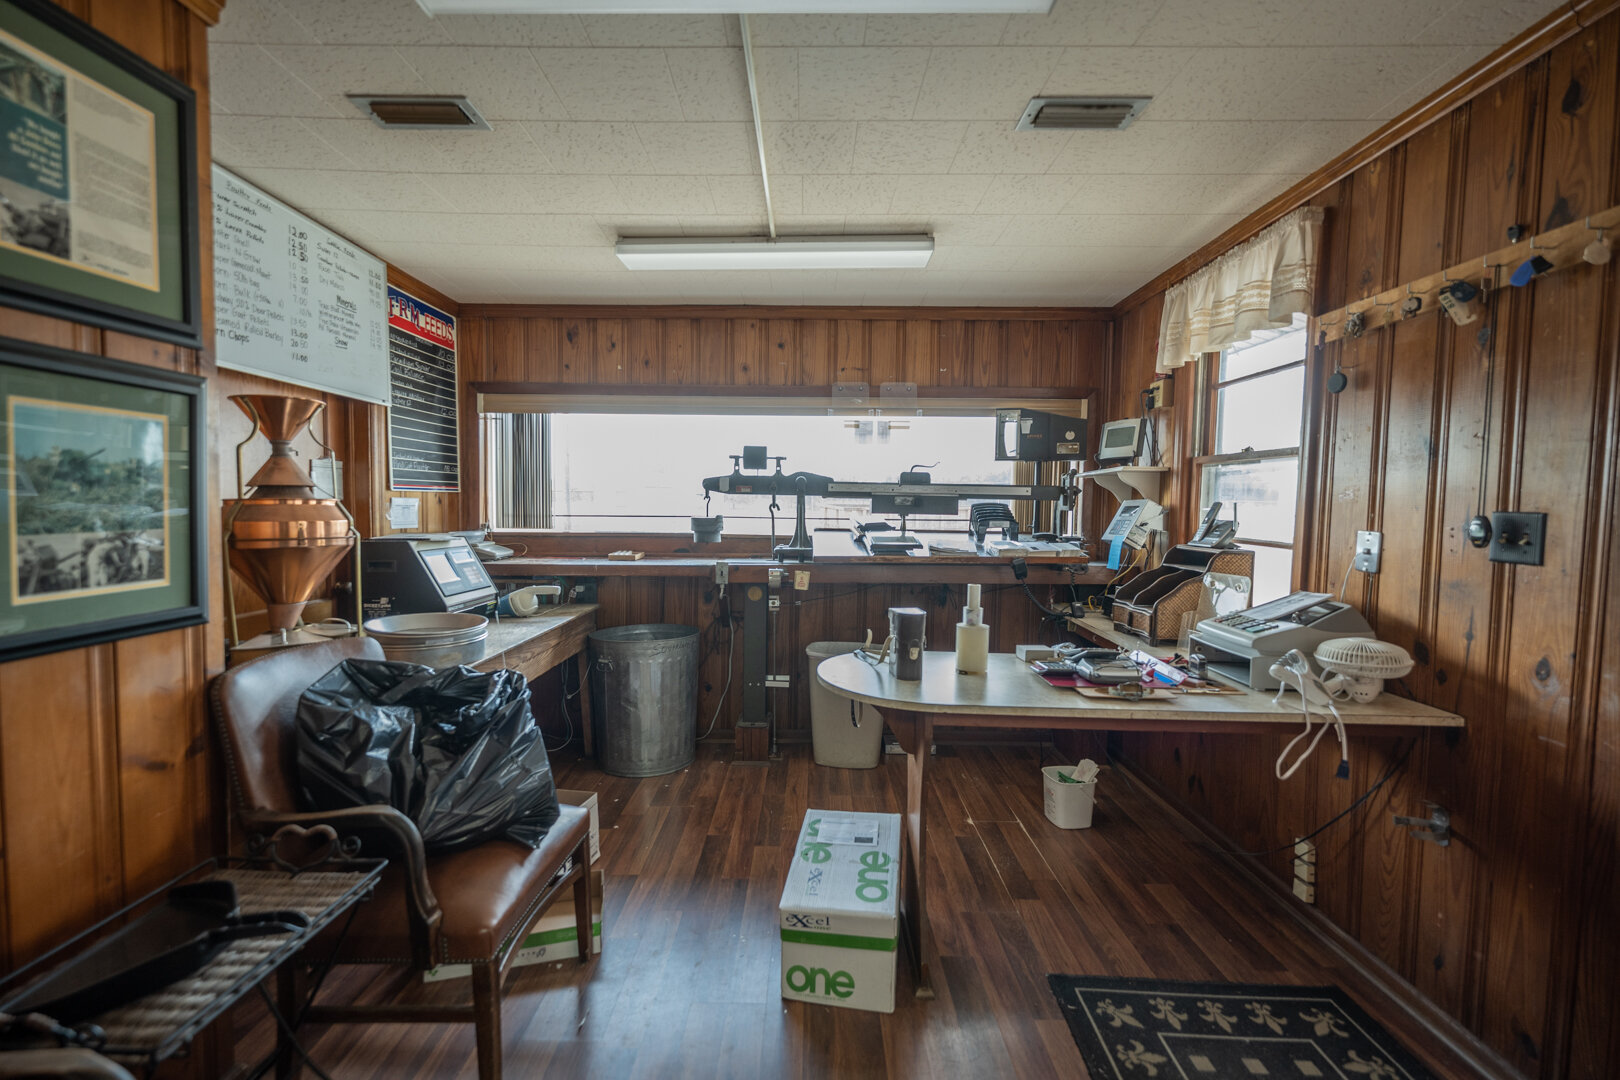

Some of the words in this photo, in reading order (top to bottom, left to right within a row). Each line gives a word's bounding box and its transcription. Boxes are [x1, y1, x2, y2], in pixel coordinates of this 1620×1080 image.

[423, 312, 454, 344] FEEDS
[855, 850, 892, 903] one
[786, 965, 856, 998] one
